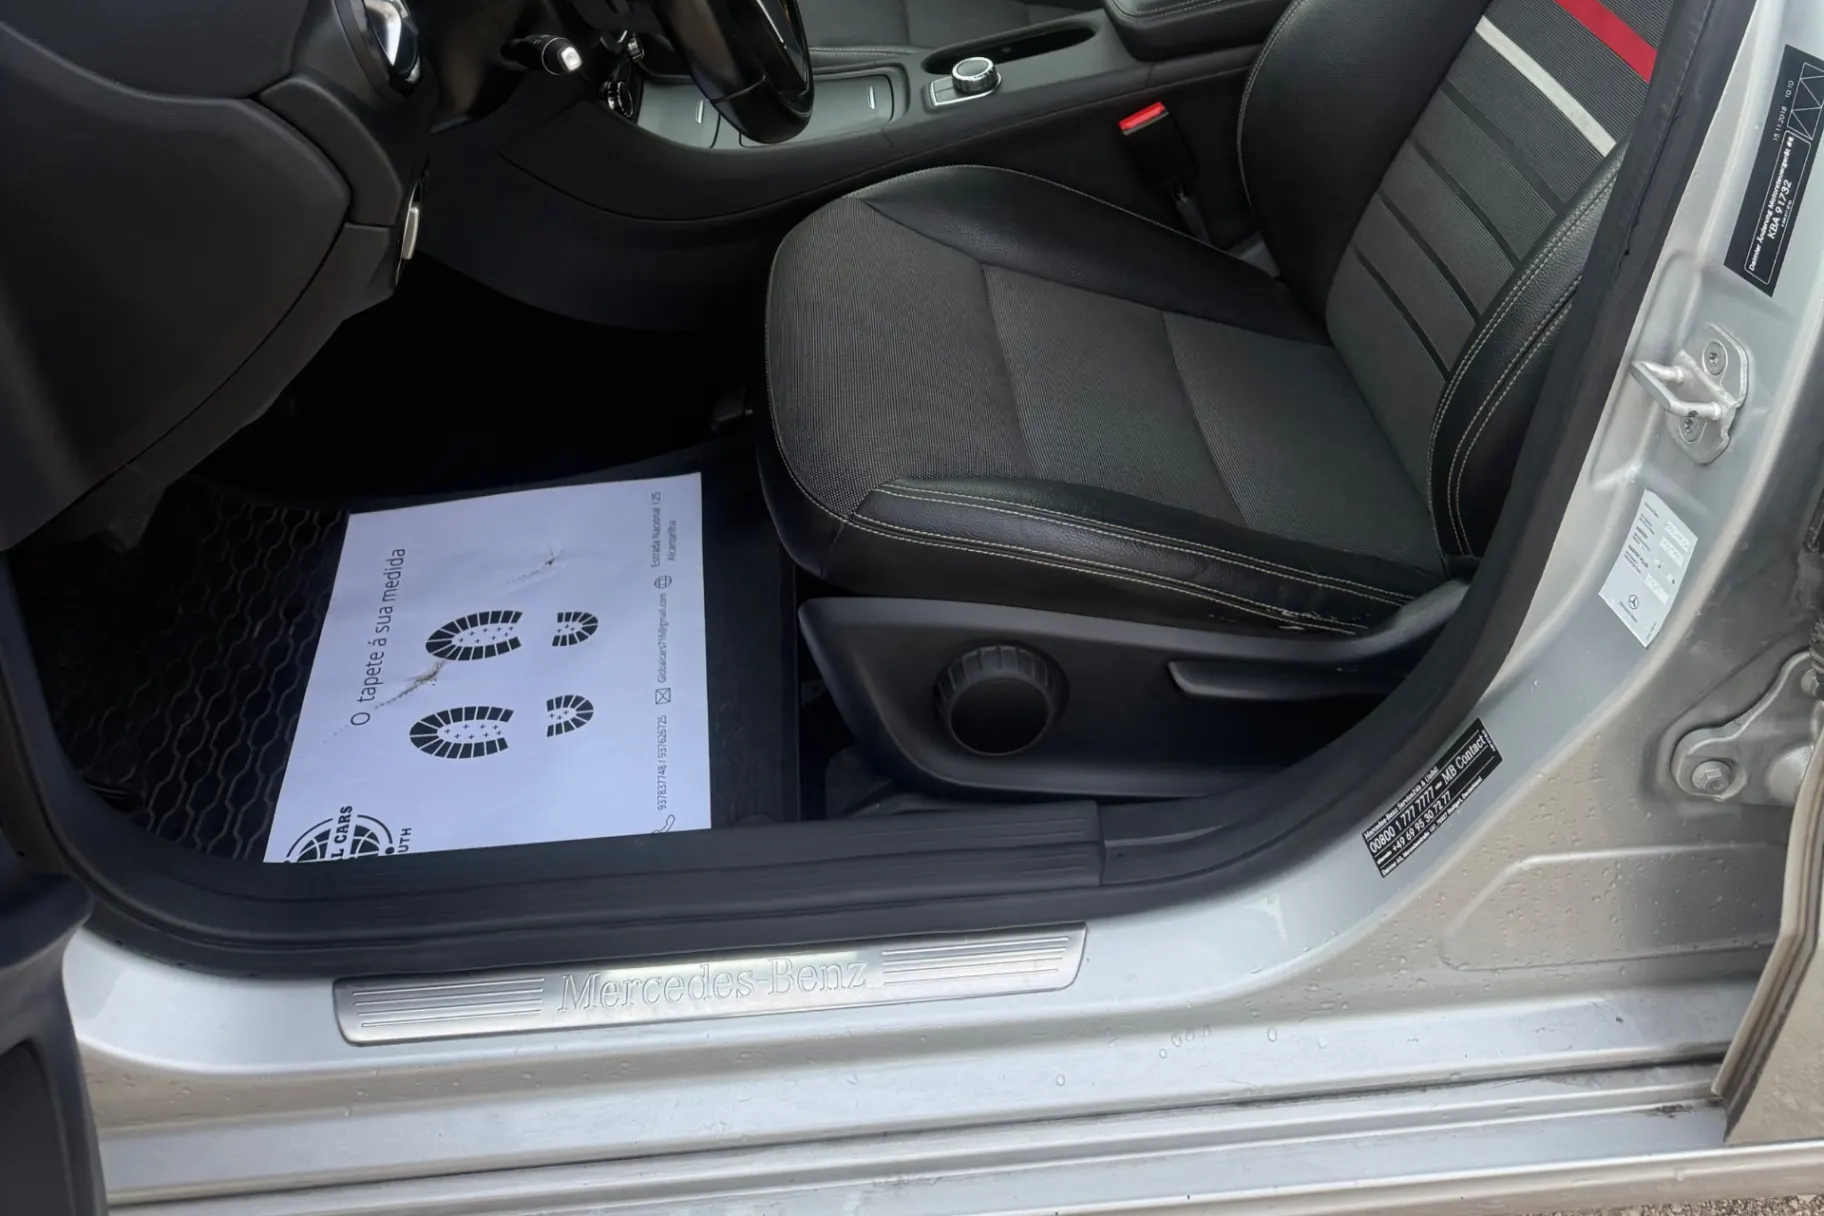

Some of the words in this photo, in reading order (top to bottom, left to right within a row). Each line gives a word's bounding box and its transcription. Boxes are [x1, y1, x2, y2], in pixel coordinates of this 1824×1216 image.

[1767, 216, 1781, 240] KBA
[1775, 179, 1792, 214] 91732
[1748, 244, 1762, 271] Daimler
[382, 548, 406, 602] medida
[367, 637, 387, 647] á
[375, 605, 393, 634] sua
[356, 651, 384, 703] tapete
[350, 712, 371, 726] O
[1369, 826, 1396, 853] 00800
[1395, 820, 1402, 831] 1
[1401, 807, 1416, 826] 777
[1415, 786, 1436, 812] 7777
[1441, 765, 1457, 785] MB
[1455, 734, 1486, 769] Contact
[333, 805, 353, 844] CARS
[398, 827, 412, 853] UTH
[1392, 837, 1405, 852] +49
[1405, 828, 1415, 841] 69
[1415, 820, 1425, 832] 95
[1424, 810, 1434, 823] 30
[1434, 801, 1444, 813] 72
[1442, 791, 1451, 804] 77
[557, 957, 868, 1012] Mercedes-Benz
